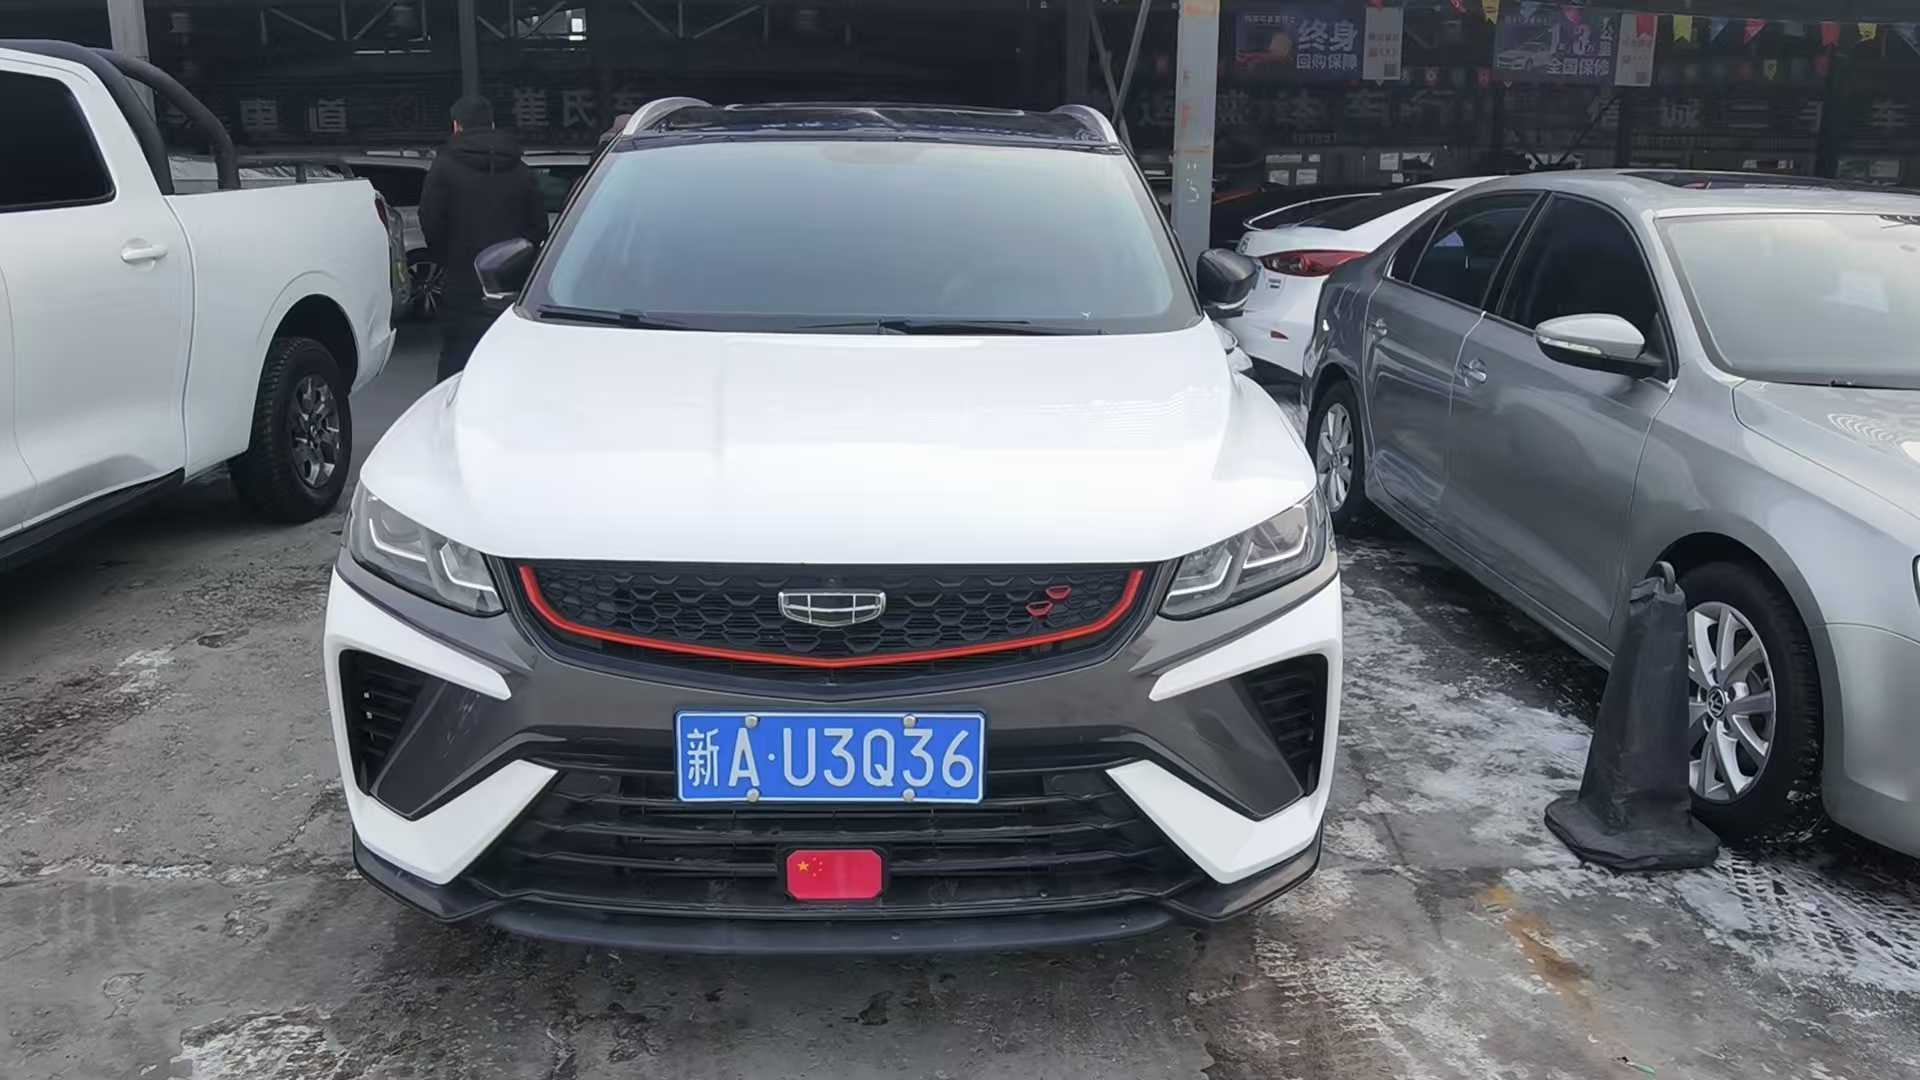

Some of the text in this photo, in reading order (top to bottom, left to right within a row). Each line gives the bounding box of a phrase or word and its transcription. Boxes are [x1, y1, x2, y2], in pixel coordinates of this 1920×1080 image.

[1296, 20, 1359, 53] 终身
[1296, 53, 1359, 71] 回购保障
[1546, 57, 1610, 77] 全国保修
[687, 727, 975, 789] 新A·U3Q36
